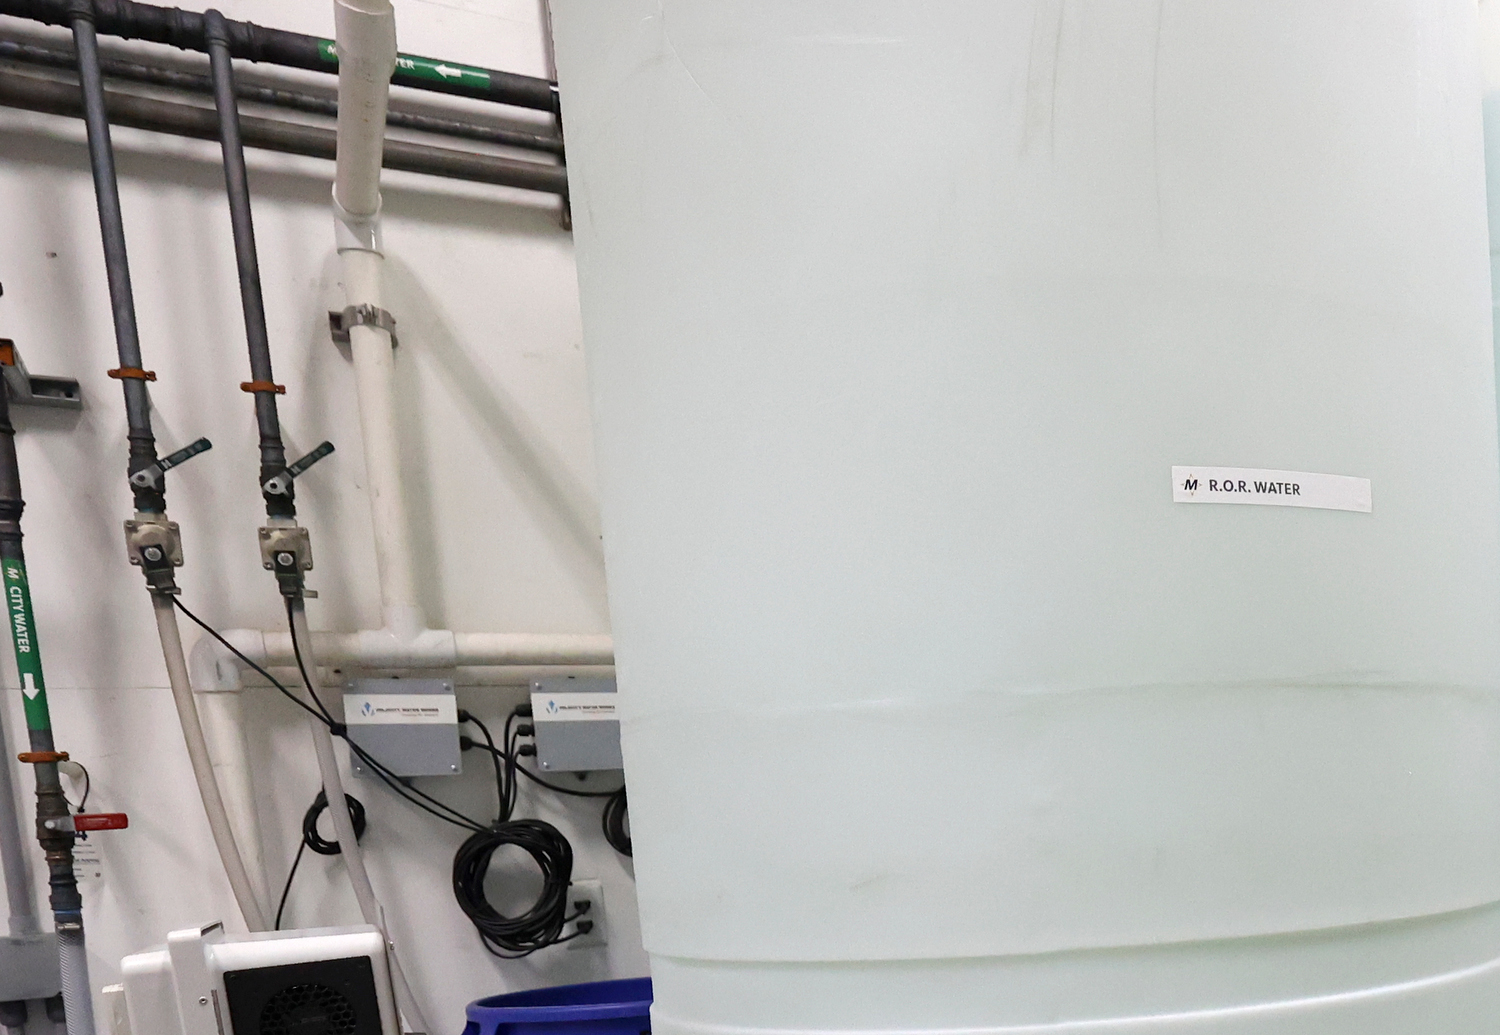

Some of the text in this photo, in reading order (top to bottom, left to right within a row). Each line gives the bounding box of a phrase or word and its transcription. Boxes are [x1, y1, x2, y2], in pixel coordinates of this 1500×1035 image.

[1209, 479, 1251, 493] R.O.R.
[1254, 481, 1301, 496] WATER
[10, 586, 25, 612] CITY
[14, 613, 31, 653] WATER
